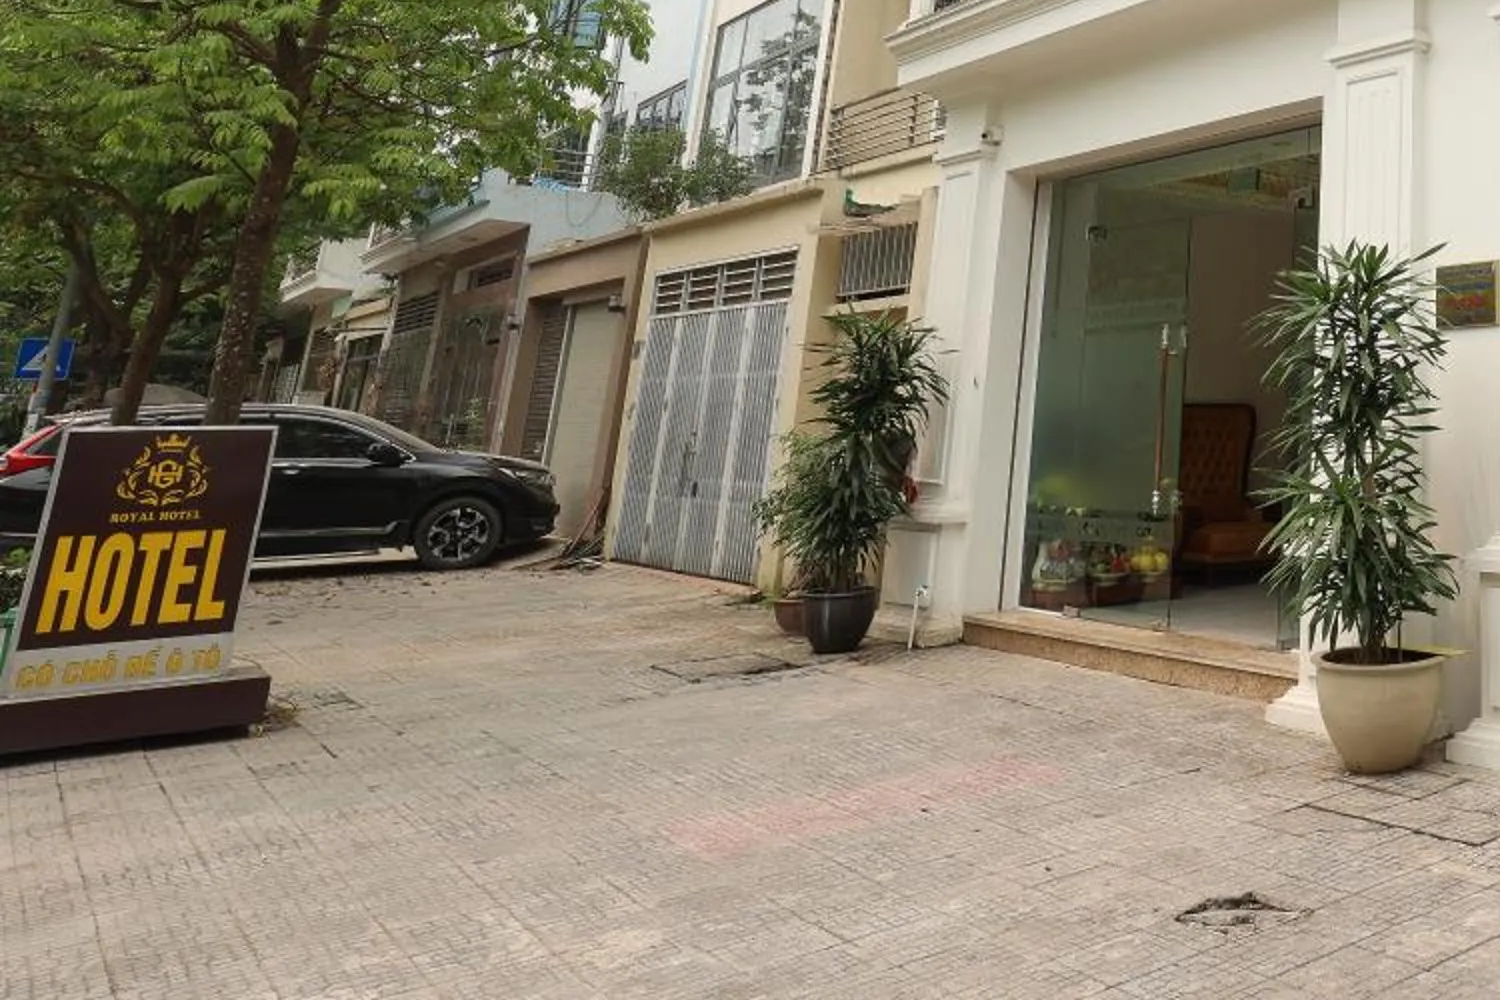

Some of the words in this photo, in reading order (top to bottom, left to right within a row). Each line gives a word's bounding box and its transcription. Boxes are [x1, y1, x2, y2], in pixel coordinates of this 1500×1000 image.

[109, 511, 155, 523] ROYAL
[159, 509, 201, 521] HOTEL
[35, 529, 227, 634] HOTEL
